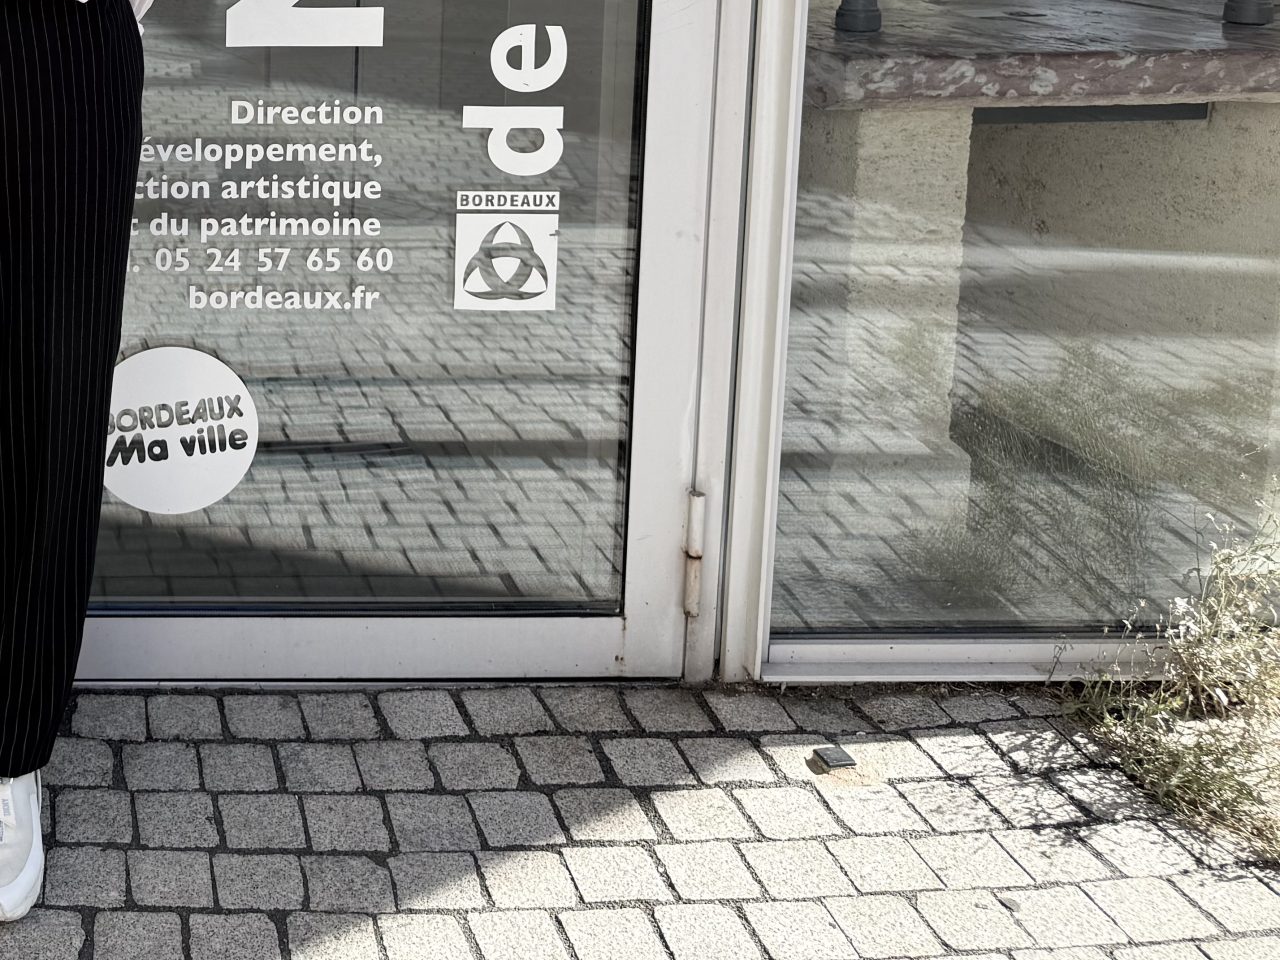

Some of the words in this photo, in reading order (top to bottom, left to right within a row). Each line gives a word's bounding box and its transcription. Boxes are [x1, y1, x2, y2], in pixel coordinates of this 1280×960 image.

[231, 100, 383, 125] Direction
[462, 23, 567, 176] de
[140, 136, 383, 169] éveloppement,
[134, 175, 210, 199] ction
[221, 175, 382, 206] artistique
[460, 194, 556, 208] BORDEAUX
[150, 212, 189, 236] du
[200, 211, 381, 243] patrimoine
[155, 248, 190, 272] 05
[206, 248, 241, 272] 24
[257, 248, 291, 272] 57
[306, 248, 341, 272] 65
[356, 248, 394, 272] 60
[189, 285, 380, 310] bordeaux.fr
[106, 432, 169, 468] Ma
[180, 424, 249, 457] ville
